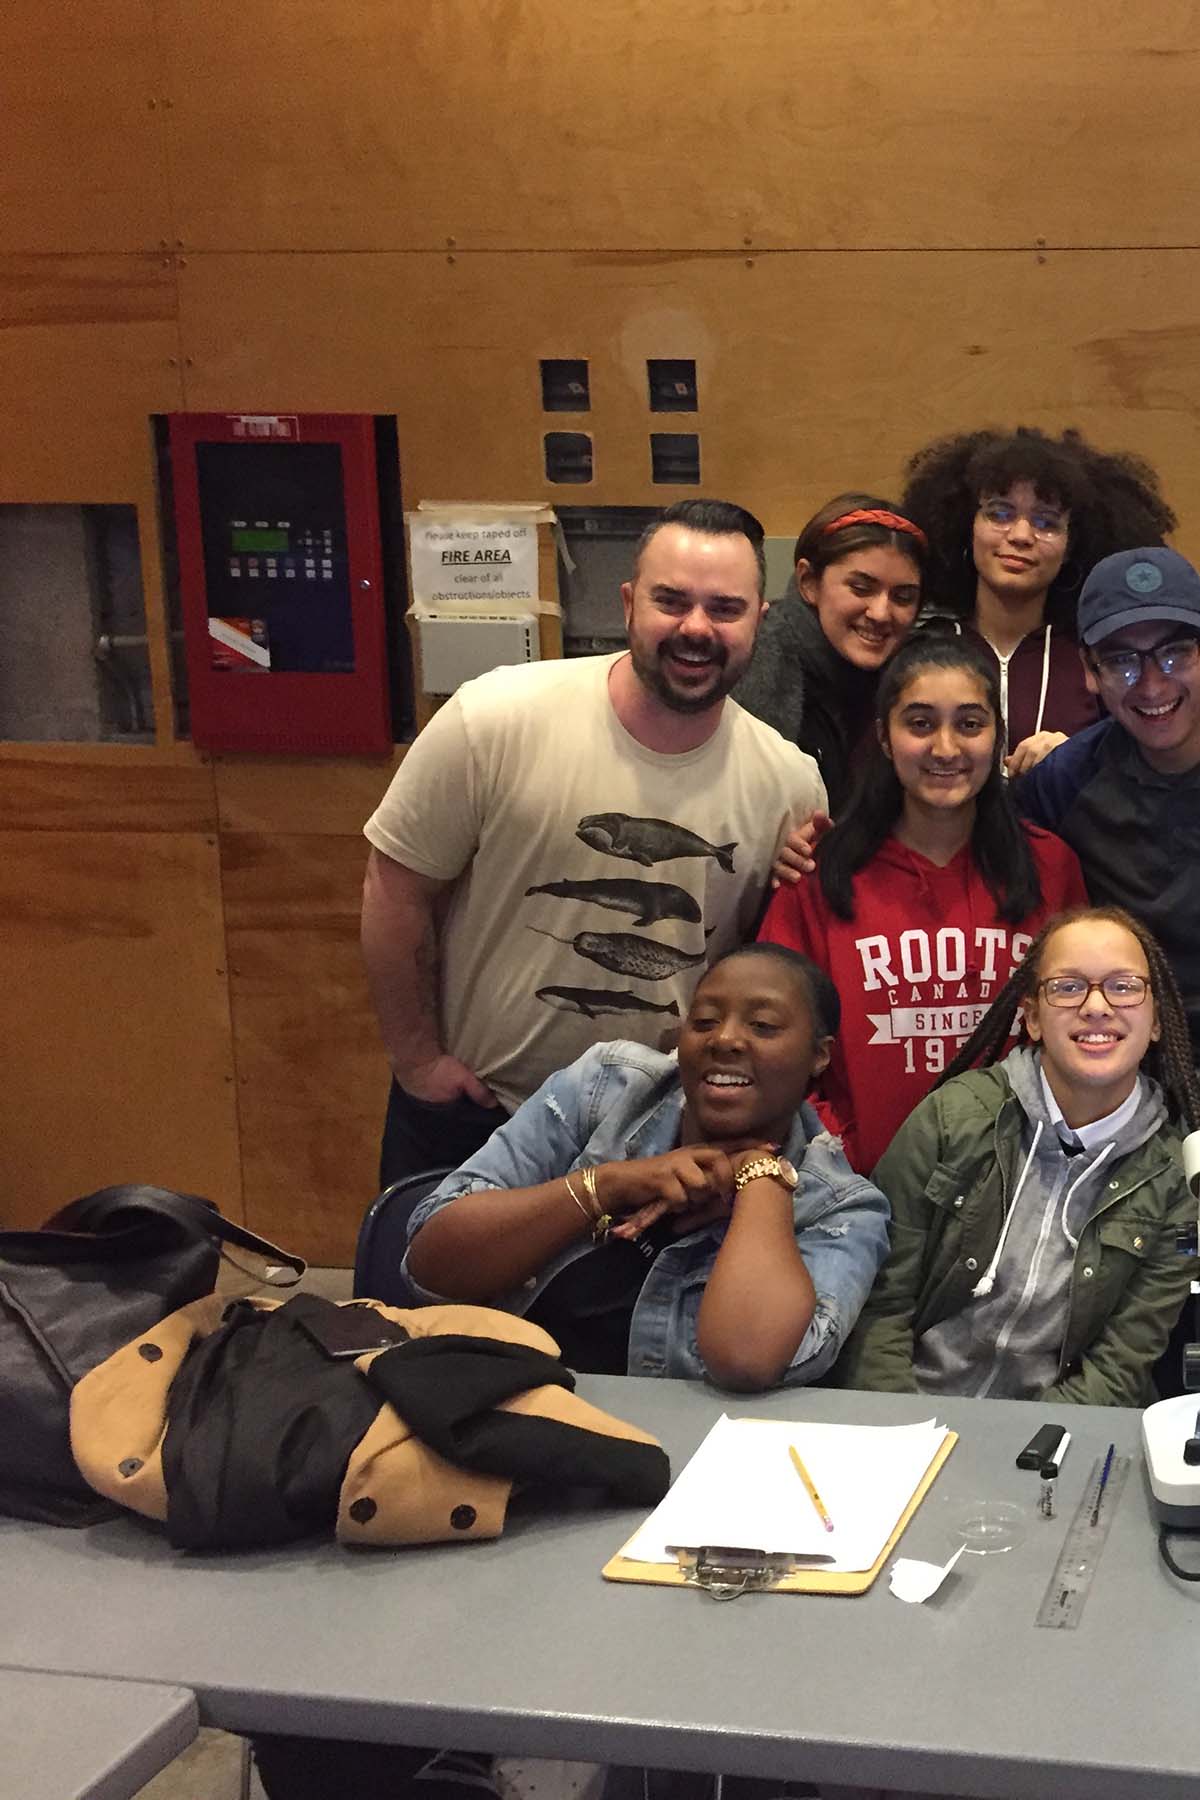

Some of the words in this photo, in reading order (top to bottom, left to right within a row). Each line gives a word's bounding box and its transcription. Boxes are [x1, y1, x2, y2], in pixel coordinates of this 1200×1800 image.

[456, 530, 479, 541] keep
[482, 529, 511, 540] taped
[513, 527, 527, 537] off
[441, 550, 470, 562] FIRE
[474, 549, 511, 562] AREA
[454, 573, 477, 583] clear
[480, 573, 491, 583] of
[855, 927, 1033, 991] ROOTS
[888, 982, 990, 1005] CANAD
[915, 1010, 983, 1030] SINCE
[903, 1038, 967, 1073] 19
